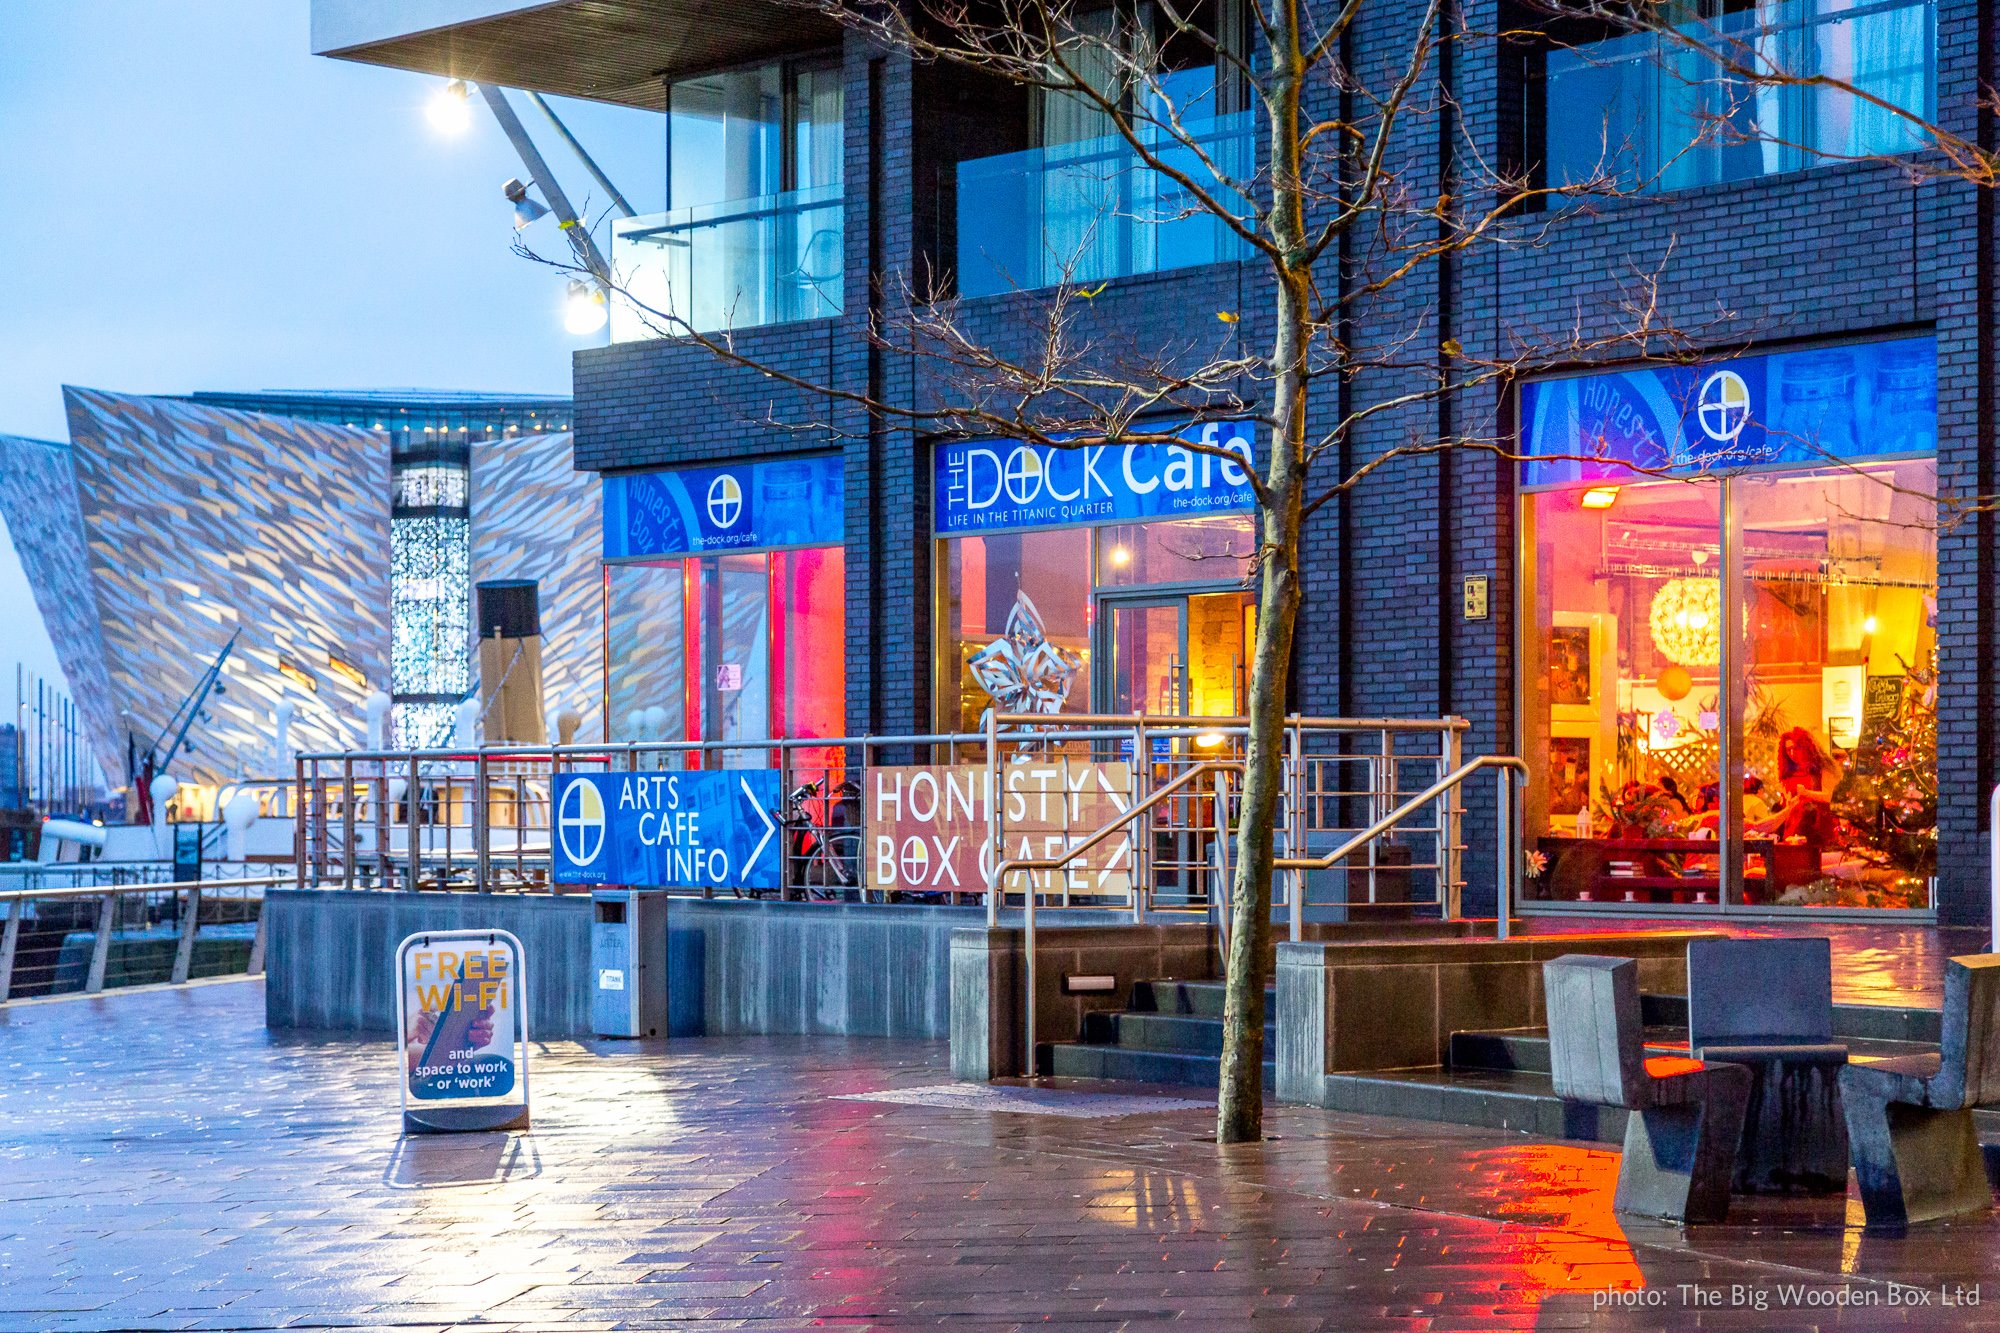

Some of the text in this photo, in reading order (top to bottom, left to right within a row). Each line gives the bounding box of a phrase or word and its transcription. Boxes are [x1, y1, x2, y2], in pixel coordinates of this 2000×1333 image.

[1584, 377, 1660, 475] Honest
[948, 451, 964, 510] THE
[968, 422, 1252, 509] DOCK Cafe
[948, 502, 1114, 527] LIFE IN THE TITANIC QUARTER
[1173, 492, 1253, 508] the-dock.org/cafe
[692, 532, 758, 546] the-dock.org/cafe
[619, 776, 679, 810] ARTS
[639, 812, 700, 846] CAFE
[666, 848, 729, 883] INFO
[877, 835, 960, 886] BOX
[414, 949, 508, 980] FREE
[416, 981, 508, 1013] Wi-Fi
[415, 1060, 508, 1078] space to work
[448, 1047, 474, 1060] and
[436, 1079, 451, 1090] or
